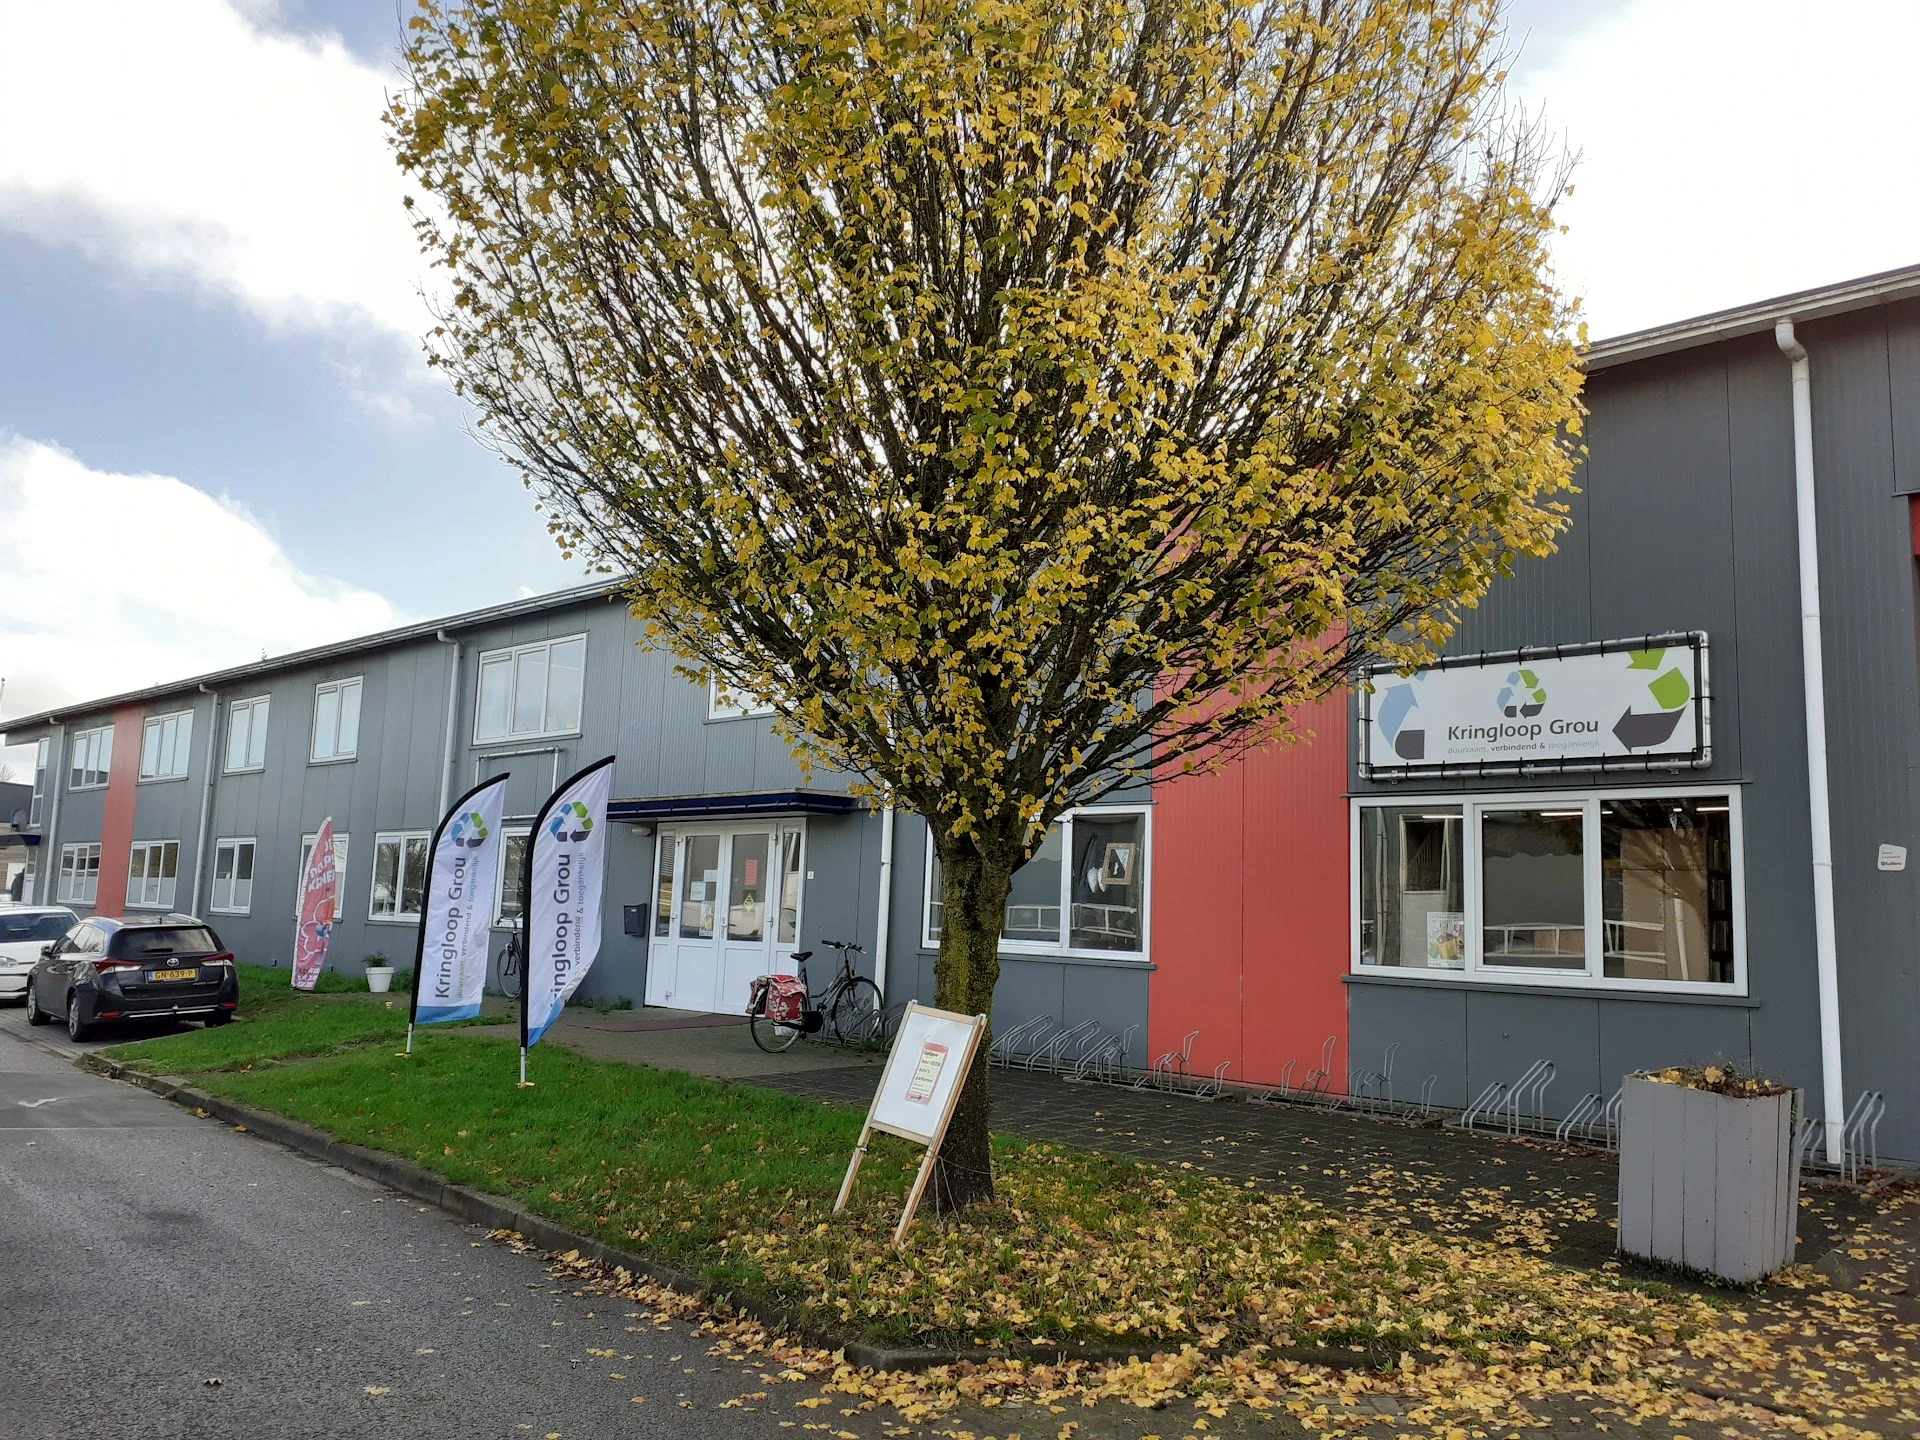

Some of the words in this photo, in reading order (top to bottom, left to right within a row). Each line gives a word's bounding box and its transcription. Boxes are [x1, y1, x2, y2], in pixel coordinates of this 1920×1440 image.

[1448, 723, 1542, 743] Kringloop
[1549, 719, 1599, 735] Grou
[1490, 742, 1537, 752] verbindend
[1548, 740, 1600, 749] toegankelijk
[448, 857, 467, 900] Grou
[554, 854, 571, 905] Grou
[578, 852, 587, 905] toegankelijk
[460, 912, 472, 956] verbindend
[468, 856, 480, 902] toegankelijk
[155, 970, 194, 979] GN-639-P
[435, 907, 463, 999] Kringloop
